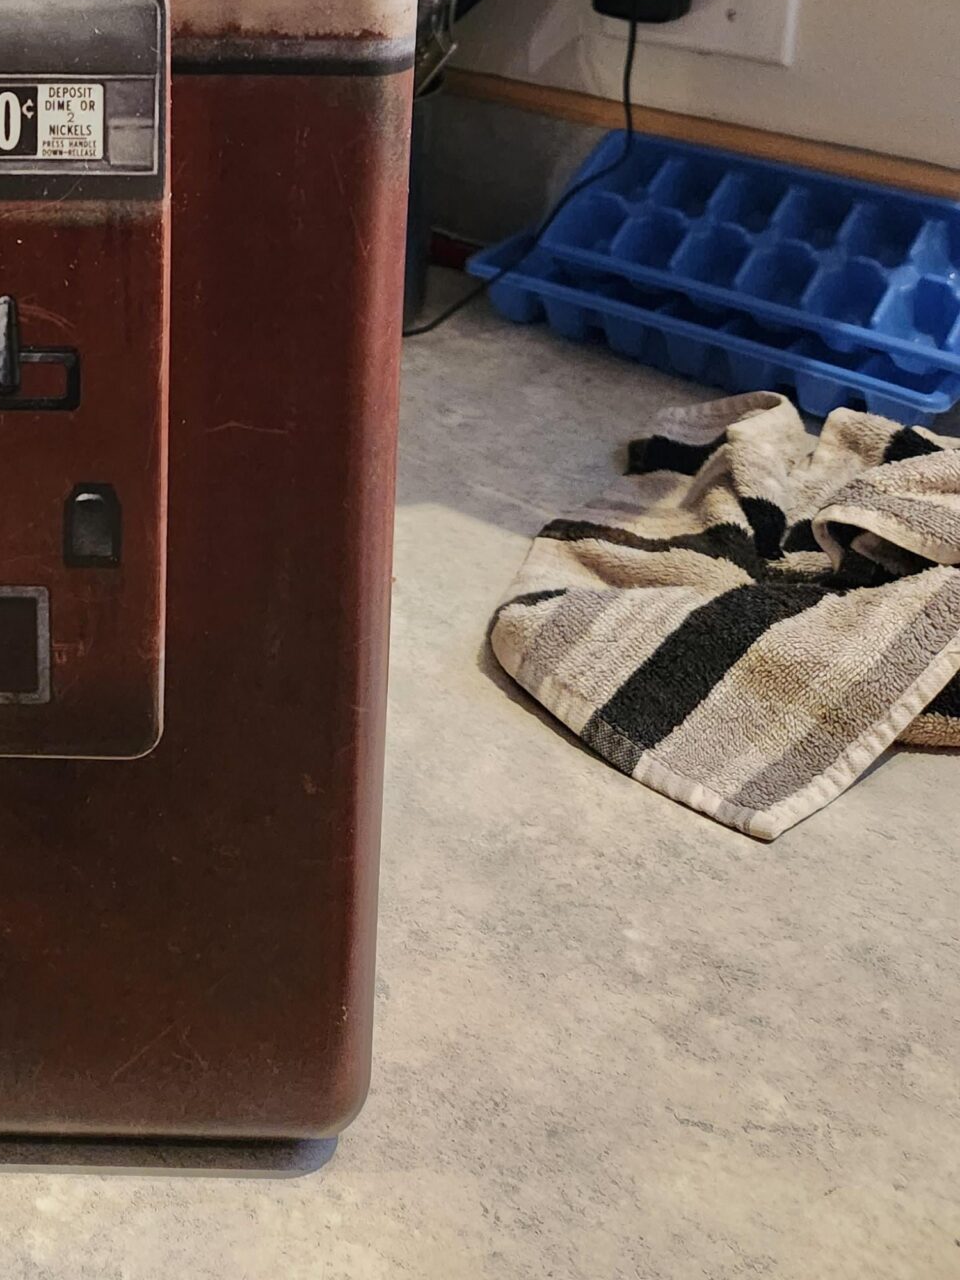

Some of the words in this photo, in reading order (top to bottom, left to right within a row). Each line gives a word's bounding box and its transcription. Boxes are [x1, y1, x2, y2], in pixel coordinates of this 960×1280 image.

[48, 86, 93, 99] DEPOSIT
[45, 100, 72, 111] DIME
[80, 100, 96, 111] OR
[66, 111, 75, 123] 2
[49, 124, 93, 136] NICKELS
[42, 140, 65, 149] PRESS
[69, 140, 97, 149] HANDLE
